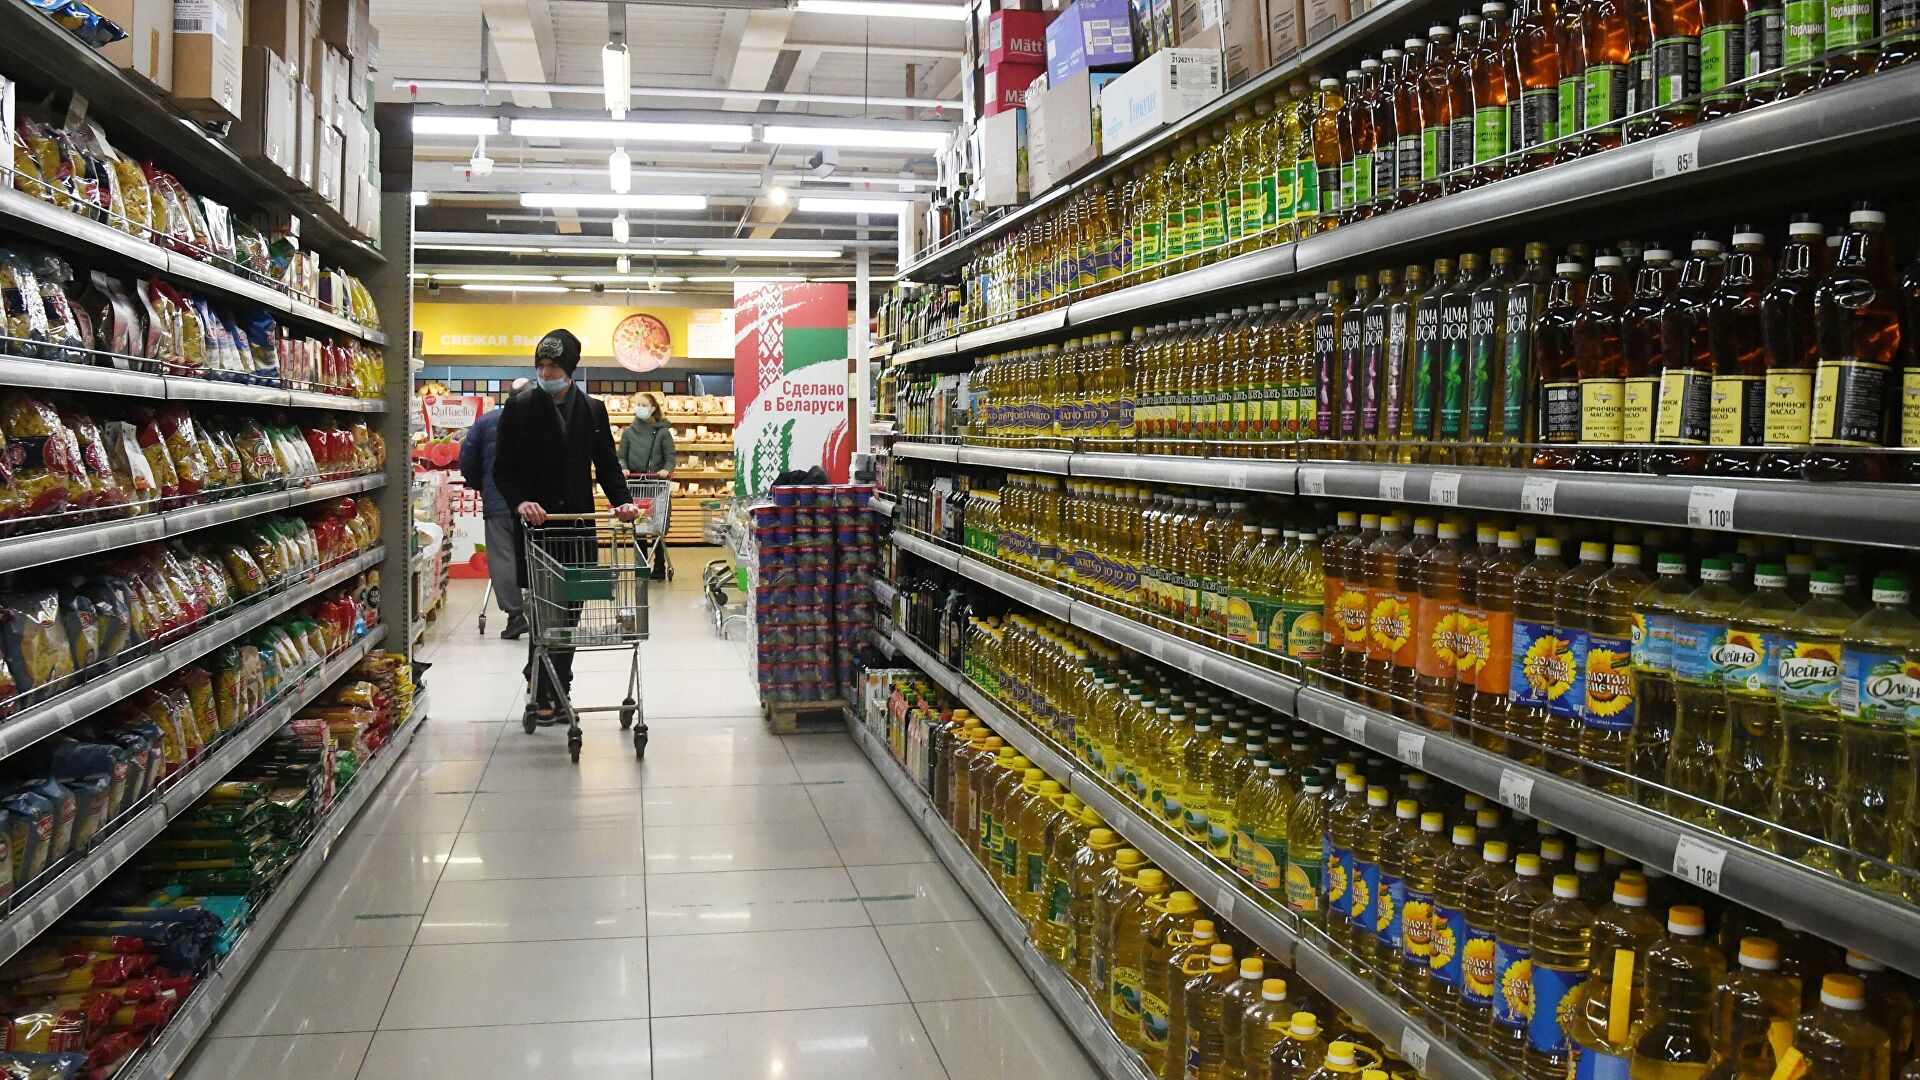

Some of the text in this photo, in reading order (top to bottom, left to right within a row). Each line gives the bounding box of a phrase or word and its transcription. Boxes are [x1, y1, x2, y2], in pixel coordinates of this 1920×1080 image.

[1831, 4, 1870, 20] Горлинка
[1171, 56, 1194, 64] 2126211
[1678, 154, 1688, 171] 85
[1473, 301, 1494, 318] ALMA
[1507, 296, 1527, 315] ALMA
[1366, 315, 1383, 330] ALMA
[1417, 309, 1437, 324] ALMA
[1442, 307, 1468, 323] ALMA
[1316, 325, 1333, 338] ALMA
[1343, 321, 1360, 335] ALMA
[1472, 318, 1493, 336] DOR
[1506, 314, 1527, 333] DOR
[1365, 330, 1382, 346] DOR
[1416, 324, 1437, 342] DOR
[1442, 323, 1467, 341] DOR
[440, 335, 508, 346] СВЕЖАЯ
[1316, 338, 1333, 353] DOR
[1343, 335, 1359, 350] DOR
[783, 381, 844, 397] Сделано
[431, 406, 475, 417] Raffaello
[764, 397, 844, 415] в Беларуси
[1442, 490, 1452, 503] 131
[1536, 497, 1549, 512] 139
[1708, 509, 1726, 527] 110
[1780, 660, 1838, 678] Олейна
[1696, 865, 1712, 887] 118
